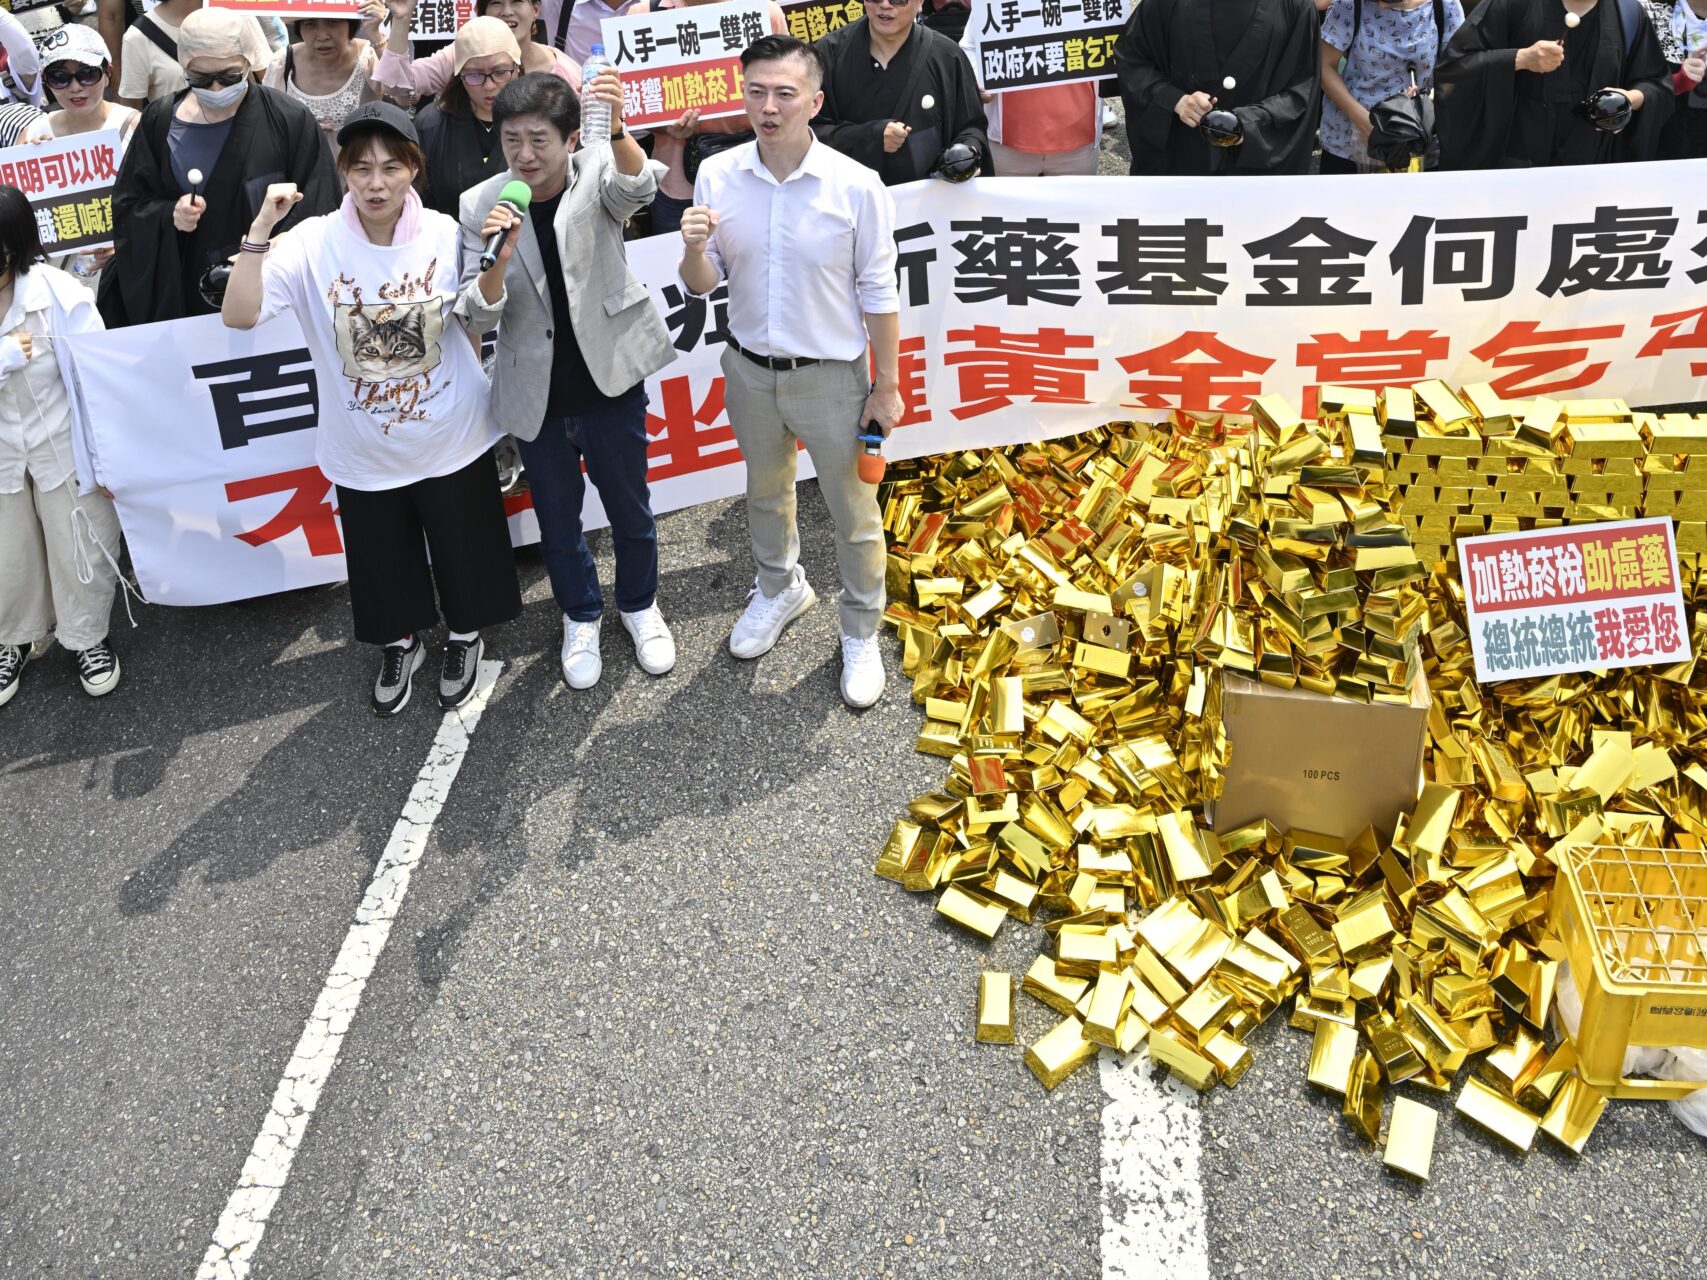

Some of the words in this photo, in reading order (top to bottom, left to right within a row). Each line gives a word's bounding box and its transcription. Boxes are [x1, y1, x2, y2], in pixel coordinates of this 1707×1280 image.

[614, 12, 765, 66] 人手一碗一雙筷
[1471, 533, 1671, 606] 加熱菸稅助癌藥
[1482, 602, 1682, 673] 總統總統我愛您
[1303, 769, 1319, 779] 100
[1320, 770, 1340, 781] PCS
